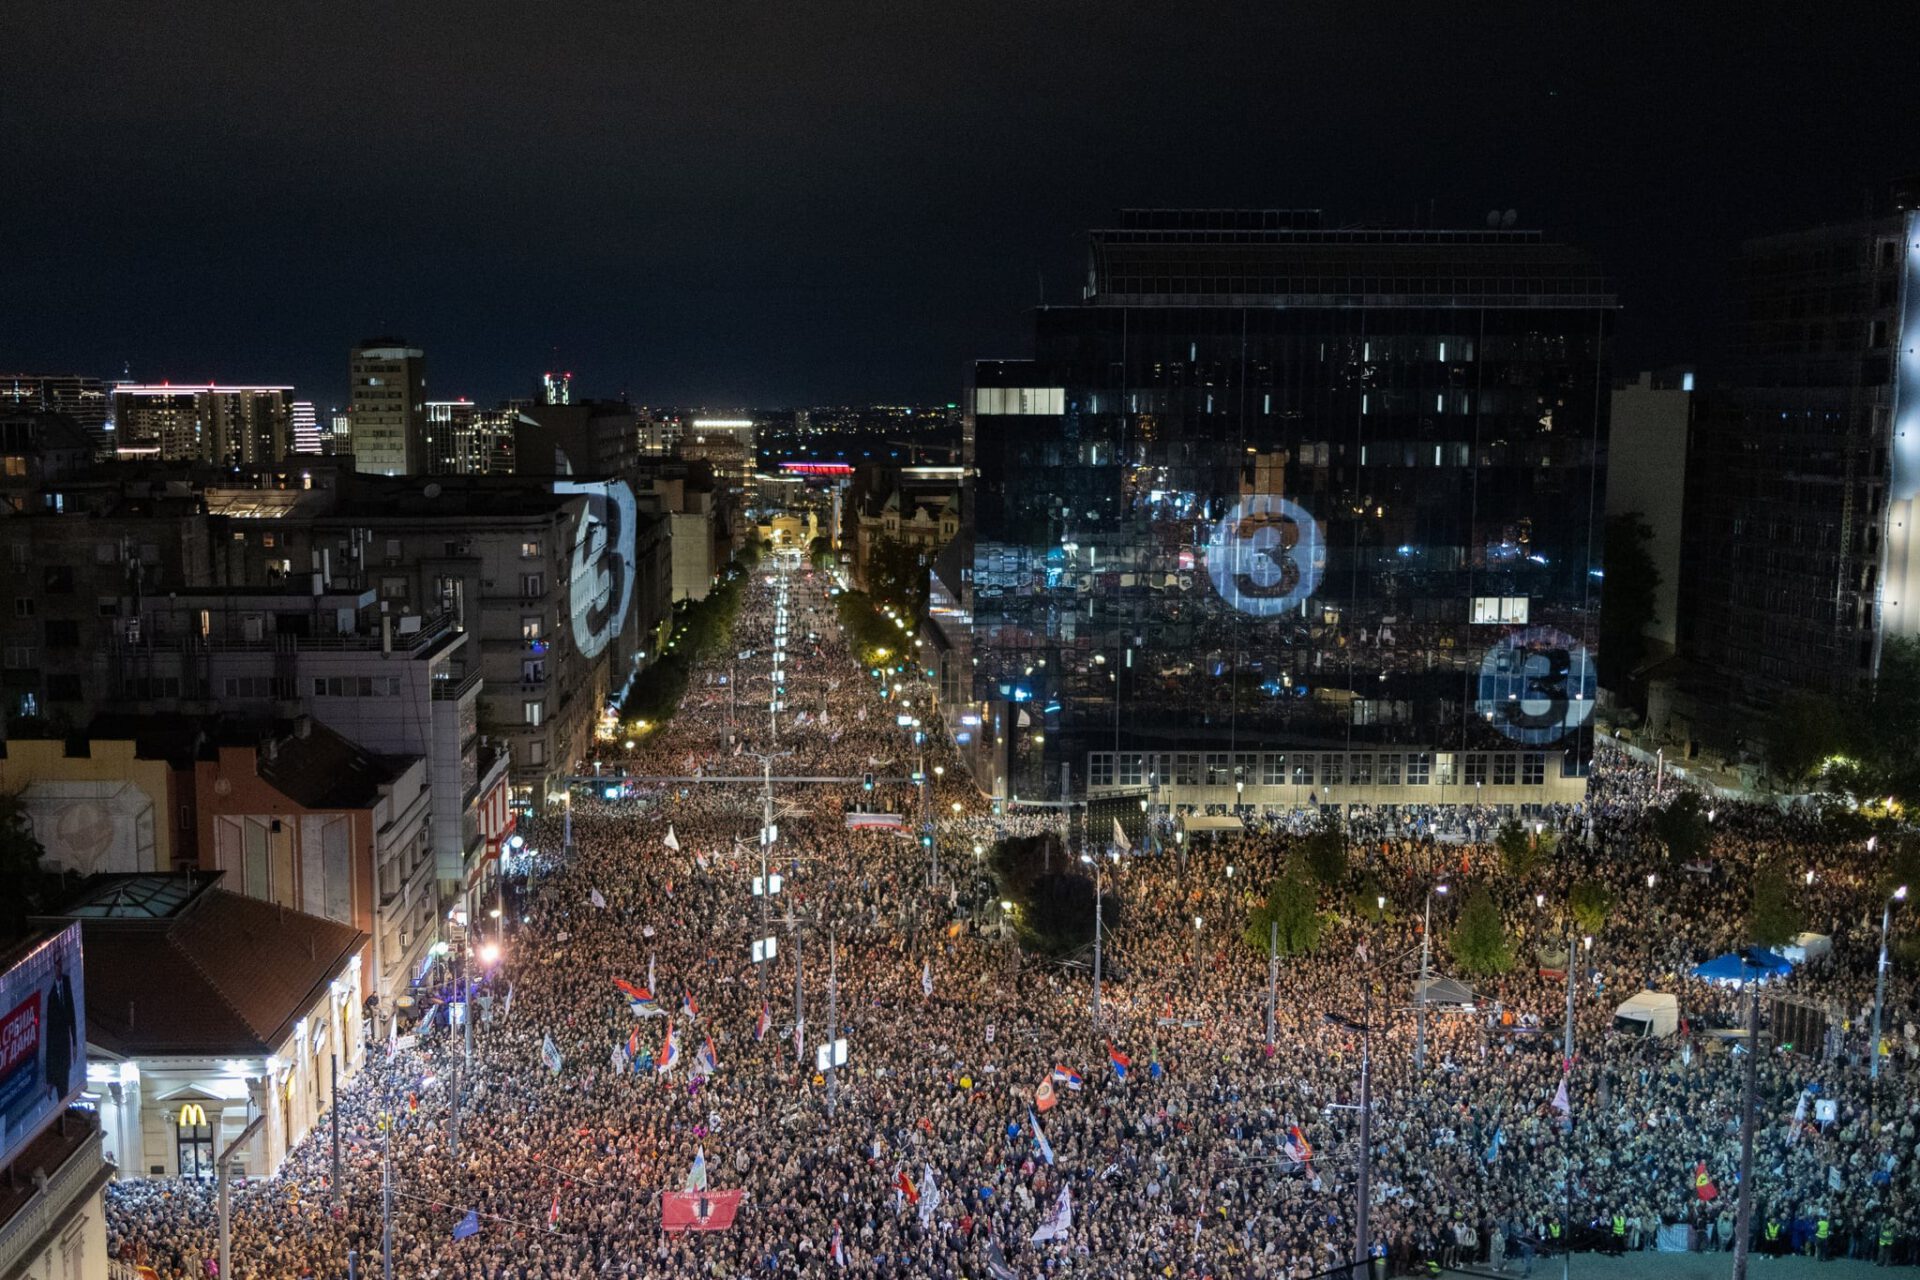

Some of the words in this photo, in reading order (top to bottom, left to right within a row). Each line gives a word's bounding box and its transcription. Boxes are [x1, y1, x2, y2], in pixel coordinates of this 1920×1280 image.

[1232, 511, 1299, 598] 3
[1501, 646, 1570, 730] 3
[9, 1025, 37, 1064] ДАНА
[180, 1104, 207, 1126] M
